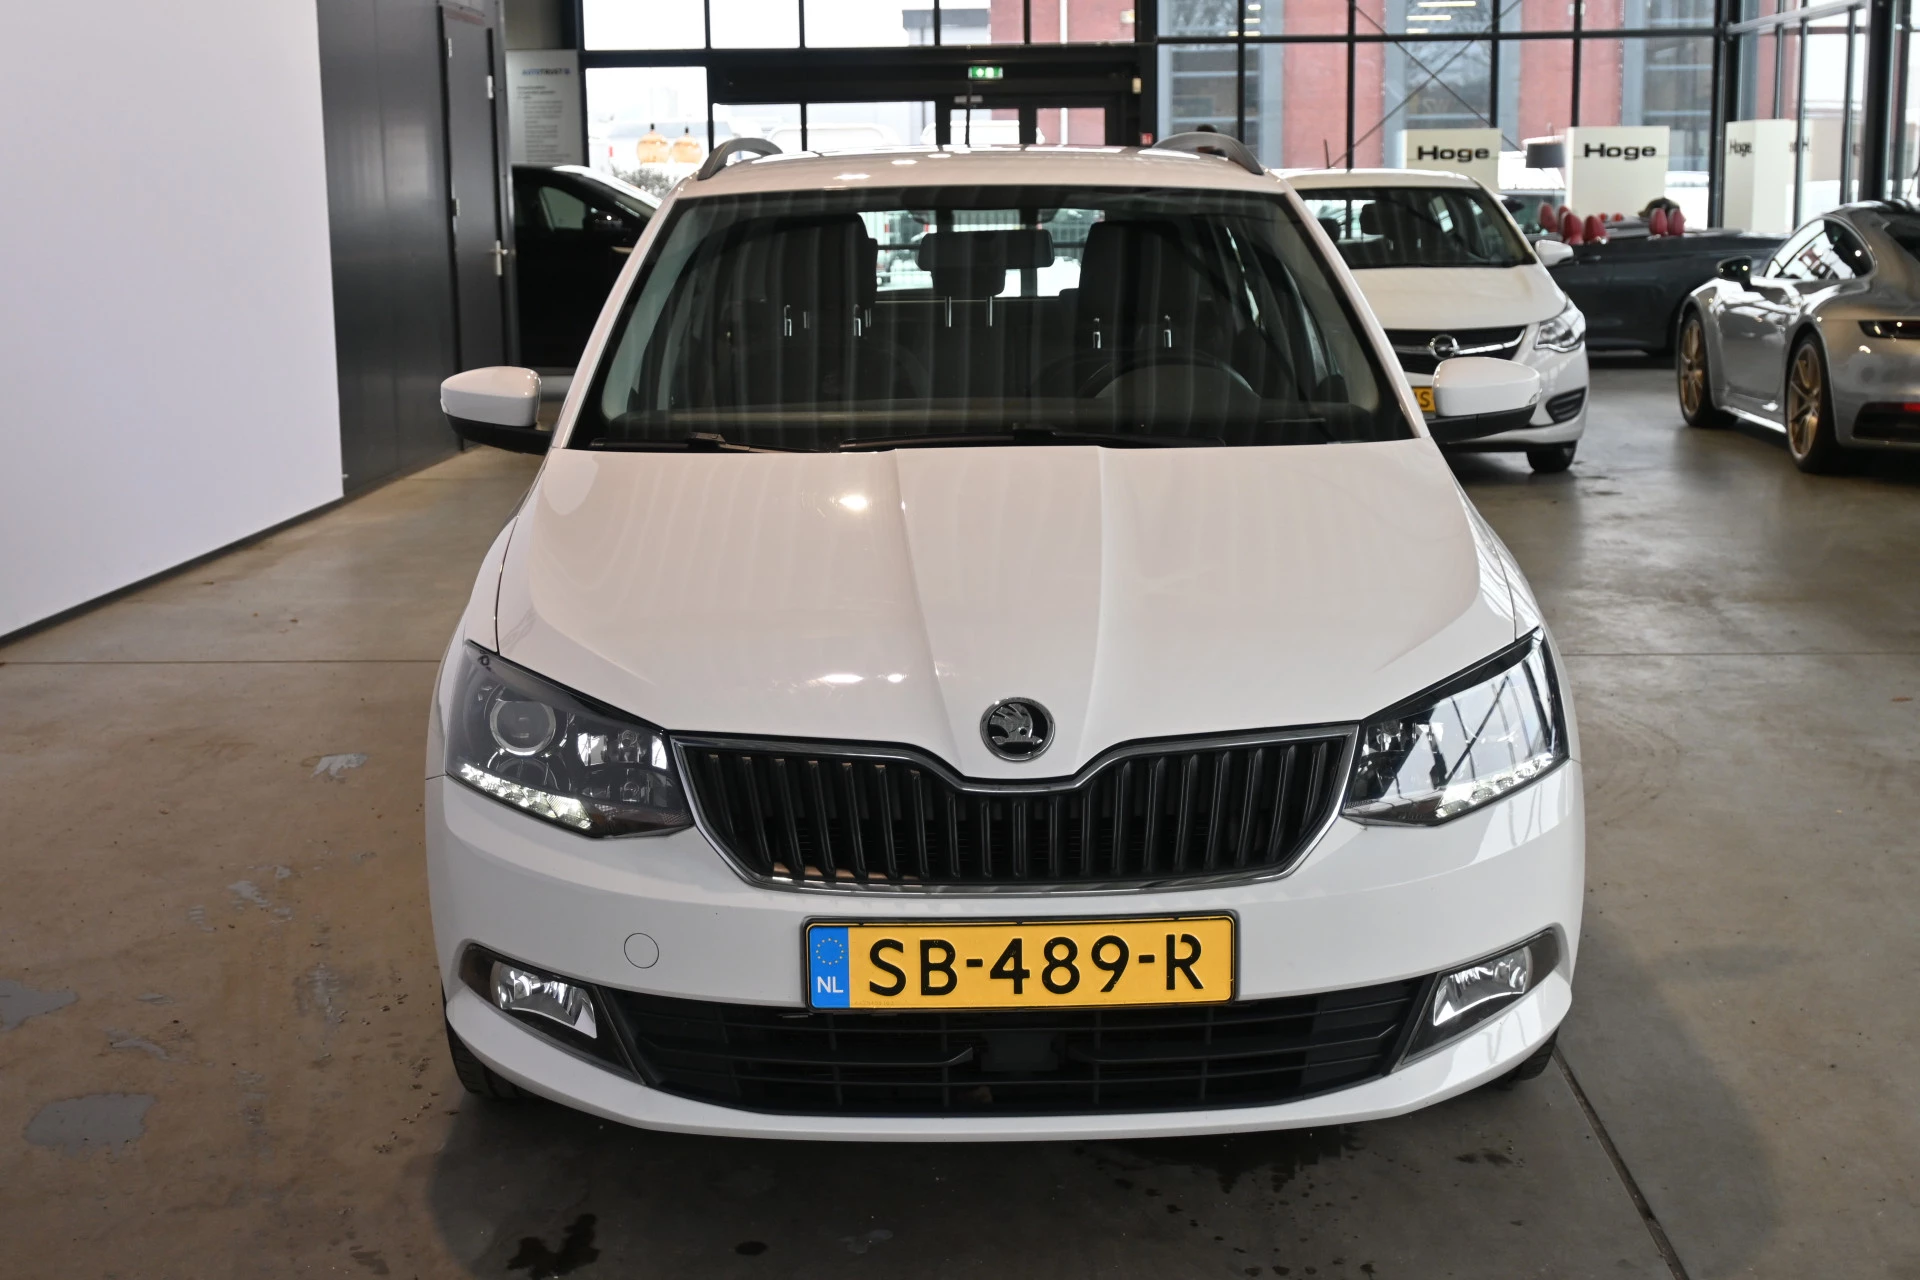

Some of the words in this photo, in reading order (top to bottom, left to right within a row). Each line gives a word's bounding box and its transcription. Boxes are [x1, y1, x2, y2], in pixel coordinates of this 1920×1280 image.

[1417, 145, 1490, 163] Hoge
[1584, 143, 1656, 161] Hoge
[868, 933, 1204, 997] SB-489-R
[817, 976, 844, 994] NL
